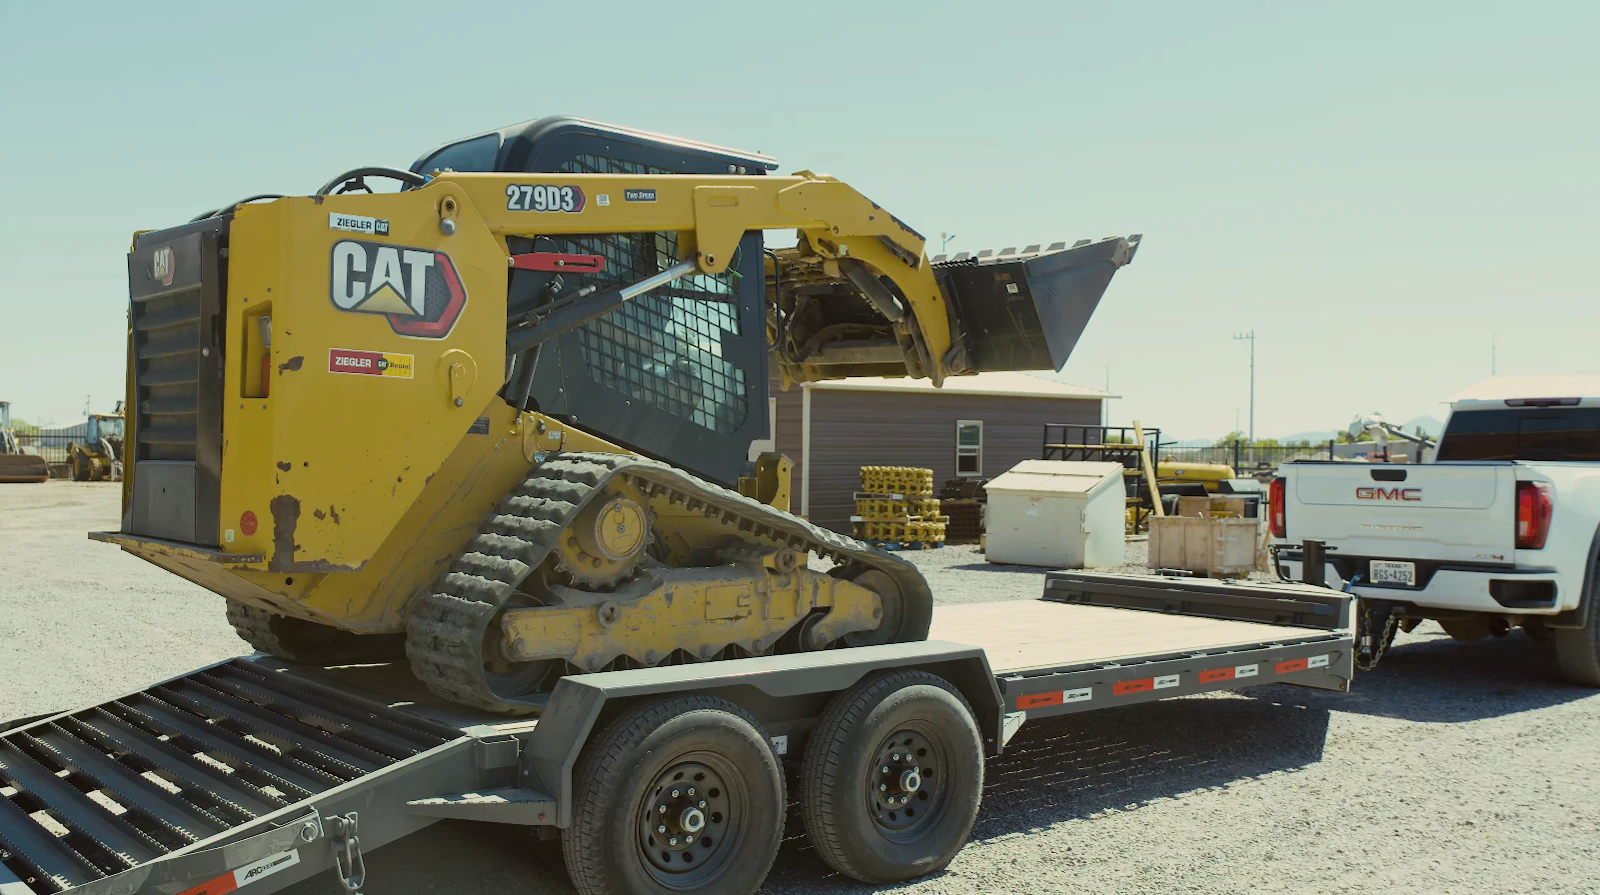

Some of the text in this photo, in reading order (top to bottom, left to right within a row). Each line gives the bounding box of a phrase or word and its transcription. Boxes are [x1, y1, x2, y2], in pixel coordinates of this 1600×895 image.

[507, 184, 574, 211] 279D3
[337, 217, 388, 232] ZIEGLER CAT
[154, 248, 170, 278] CAT
[333, 240, 435, 316] CAT
[335, 356, 372, 368] ZIEGLER
[389, 361, 411, 370] Rental
[1356, 487, 1423, 501] GMC
